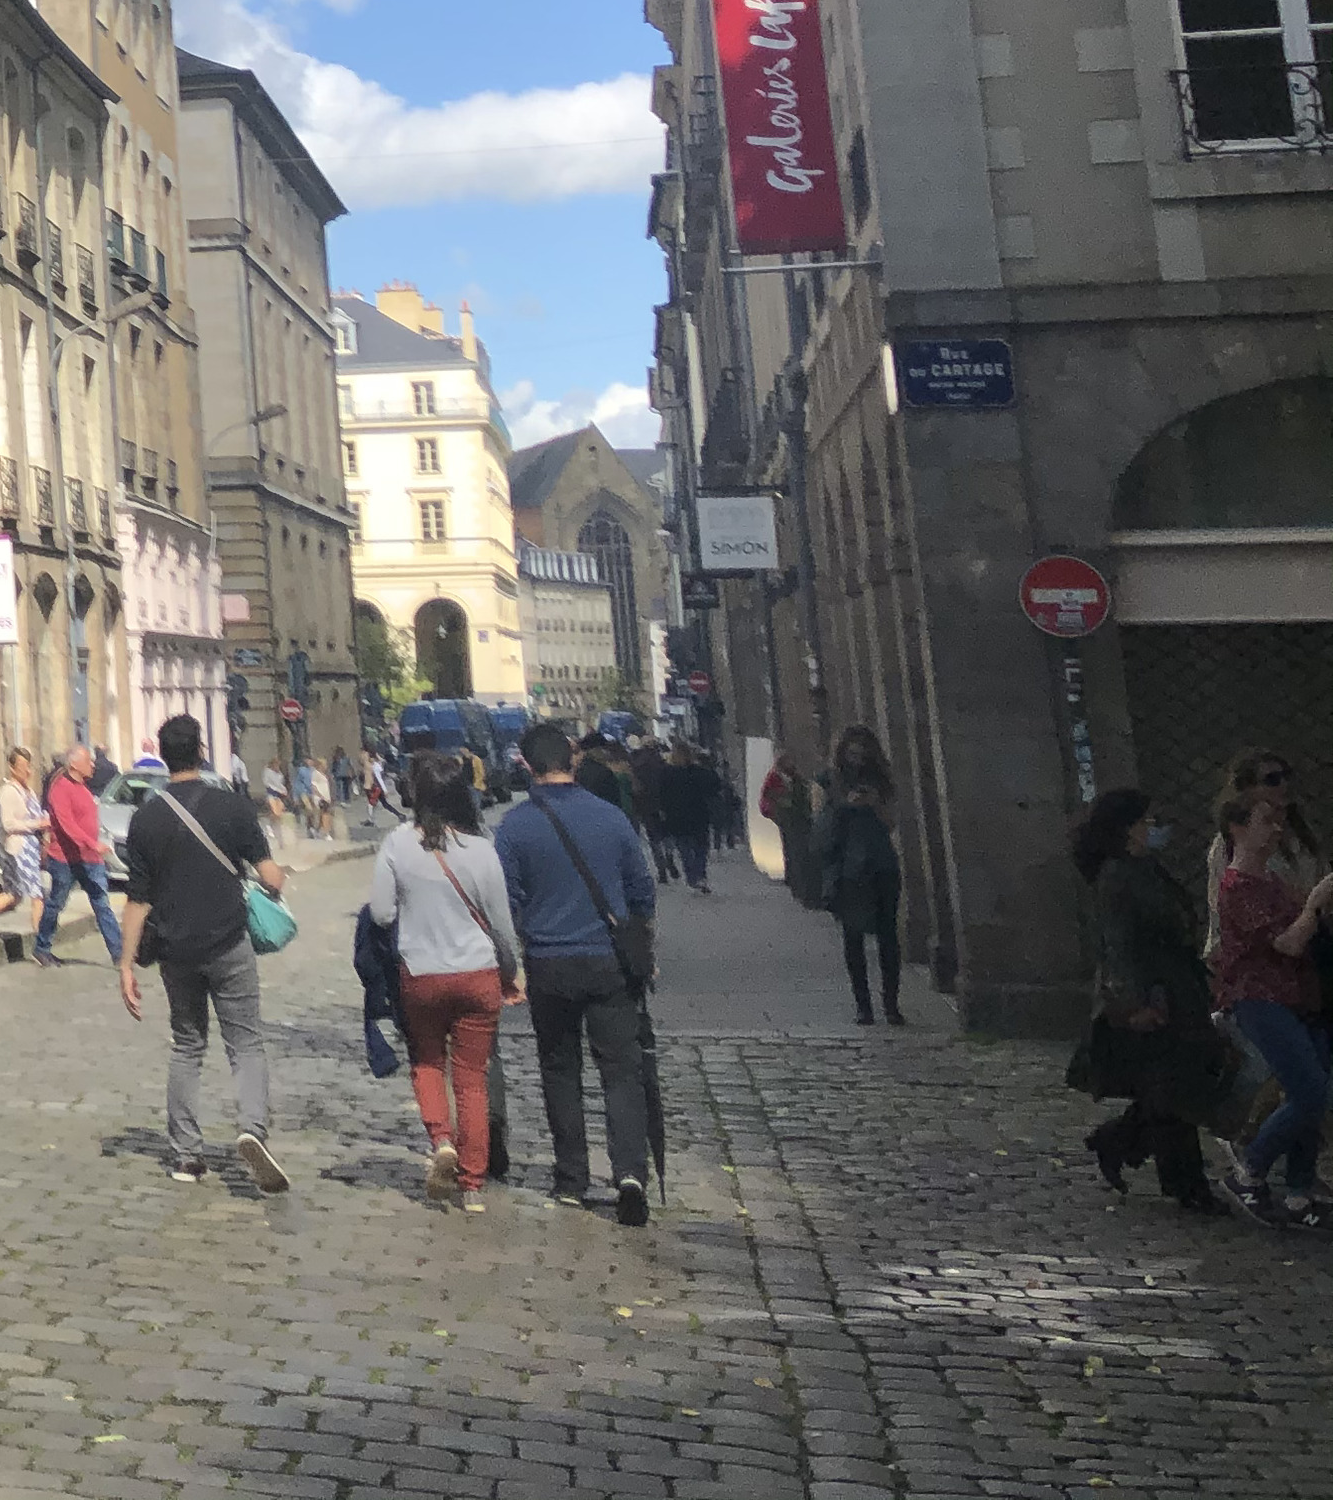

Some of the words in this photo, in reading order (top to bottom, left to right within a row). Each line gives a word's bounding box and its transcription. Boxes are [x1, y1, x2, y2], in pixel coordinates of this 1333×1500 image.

[746, 57, 825, 192] Galeries
[931, 363, 1005, 377] CARTAGE
[711, 541, 769, 555] SIMON
